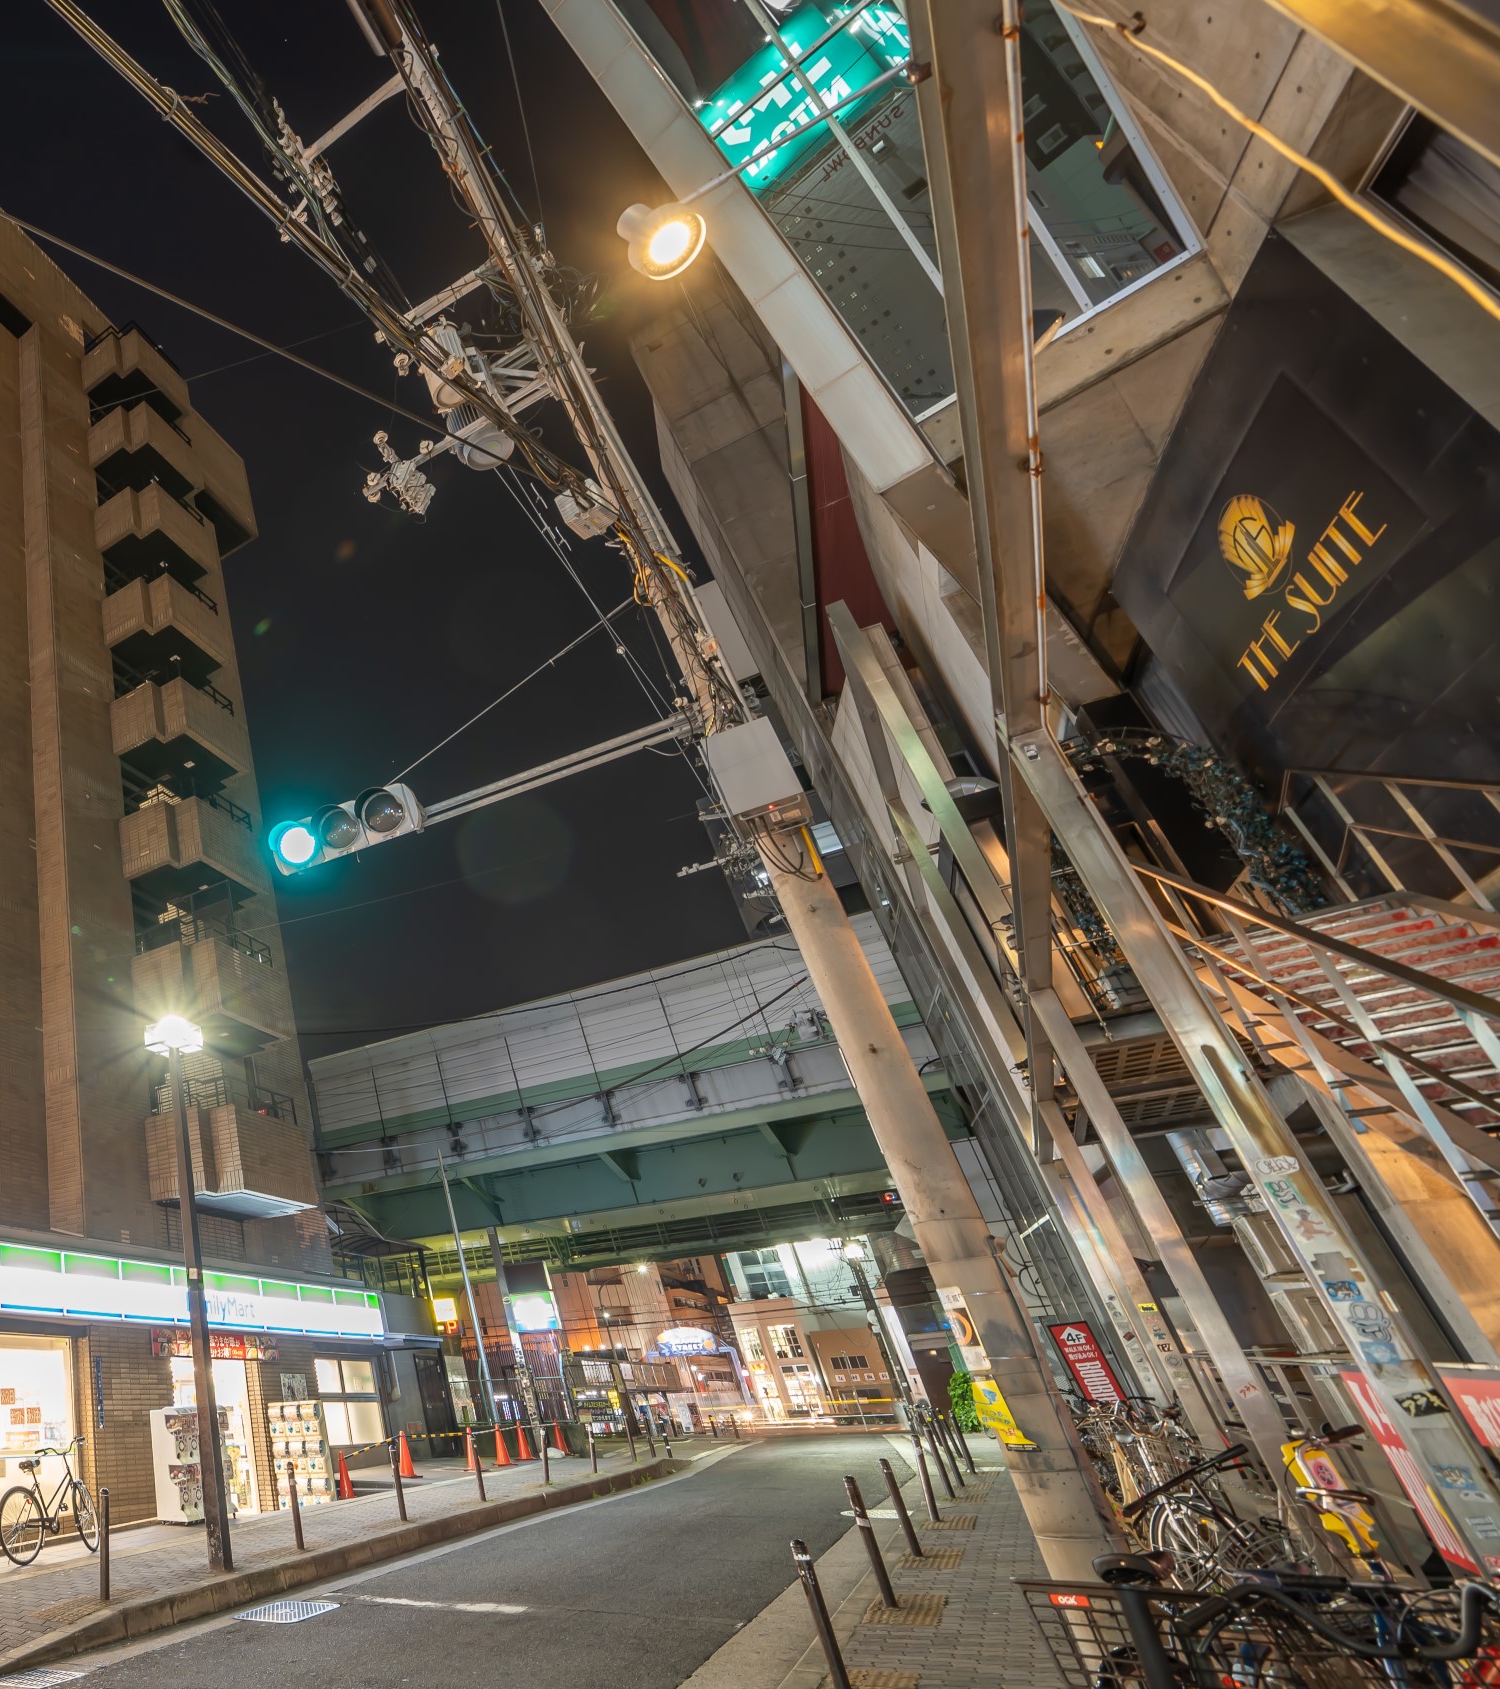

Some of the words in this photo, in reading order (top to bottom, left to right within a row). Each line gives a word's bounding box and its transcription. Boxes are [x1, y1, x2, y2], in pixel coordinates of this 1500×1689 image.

[1236, 609, 1300, 691] THE
[1284, 490, 1387, 633] SUITE
[186, 1289, 256, 1321] milyMart
[1066, 1332, 1083, 1343] 4F
